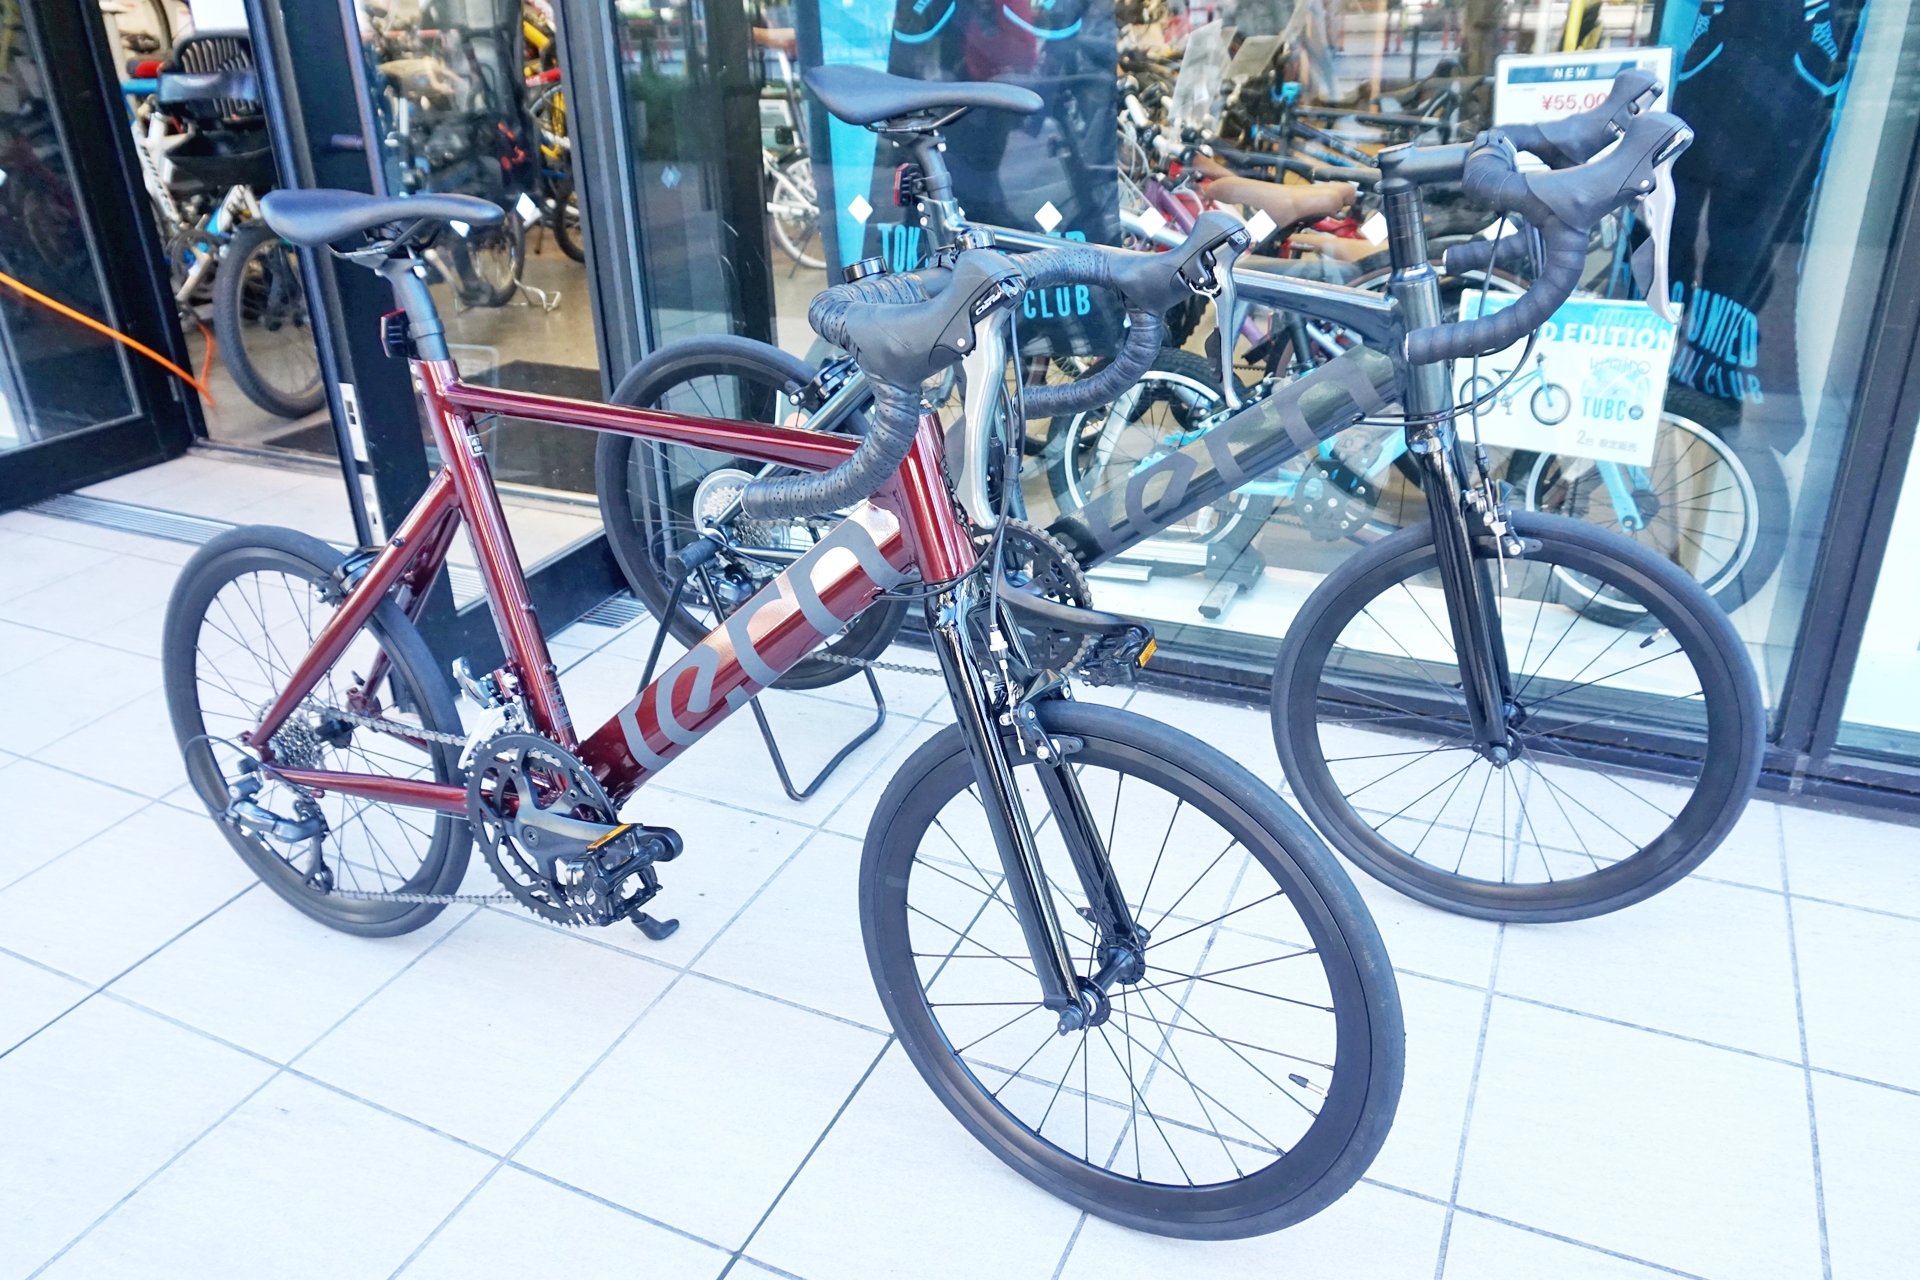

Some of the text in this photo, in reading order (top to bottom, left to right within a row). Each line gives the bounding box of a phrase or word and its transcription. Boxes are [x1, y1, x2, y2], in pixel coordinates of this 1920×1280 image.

[1552, 67, 1589, 79] NEW
[1023, 285, 1091, 320] CLUB
[1563, 322, 1674, 350] EDITION
[1687, 288, 1759, 368] UNITED
[1704, 362, 1765, 405] CLUB
[1582, 396, 1627, 421] TUBC
[1083, 355, 1389, 554] tern
[617, 517, 908, 771] tern
